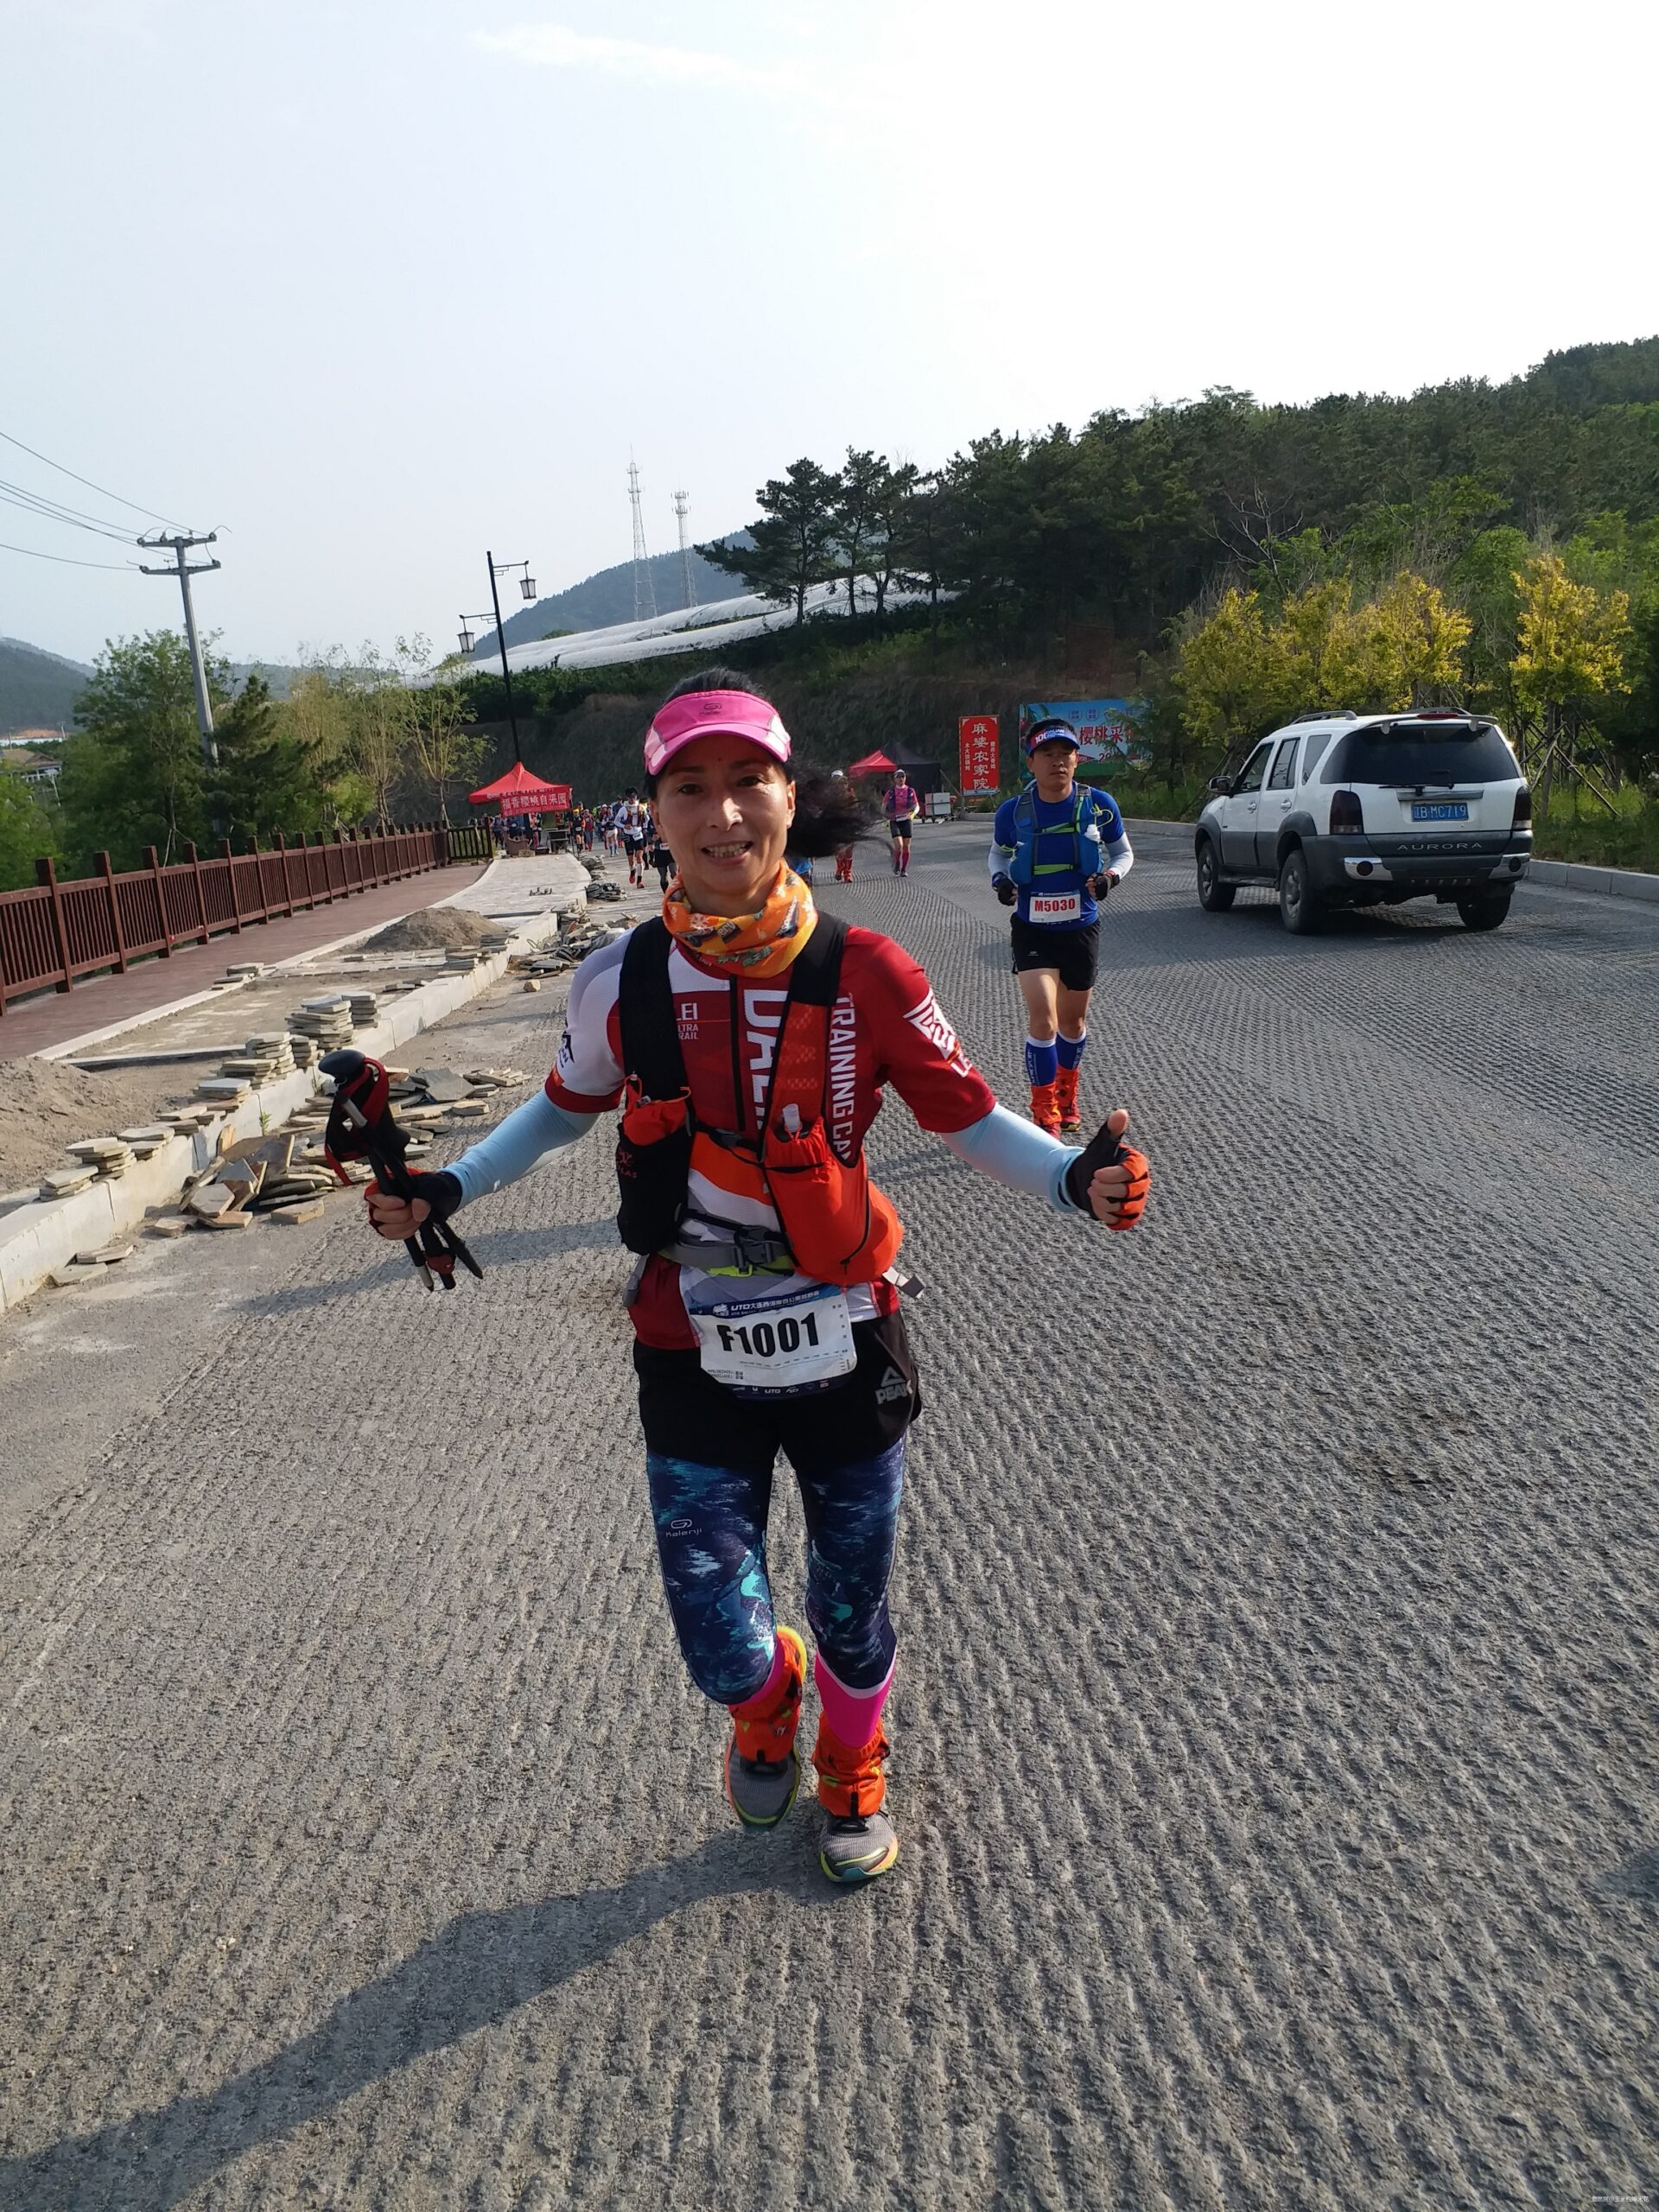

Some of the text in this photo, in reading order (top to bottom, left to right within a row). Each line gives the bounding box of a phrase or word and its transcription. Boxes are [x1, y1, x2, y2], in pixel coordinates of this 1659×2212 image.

[1079, 726, 1132, 745] 樱桃采
[1397, 842, 1483, 851] AURORA
[1034, 898, 1076, 912] M5030
[829, 993, 856, 1119] TRAINING
[716, 1312, 819, 1358] F1001
